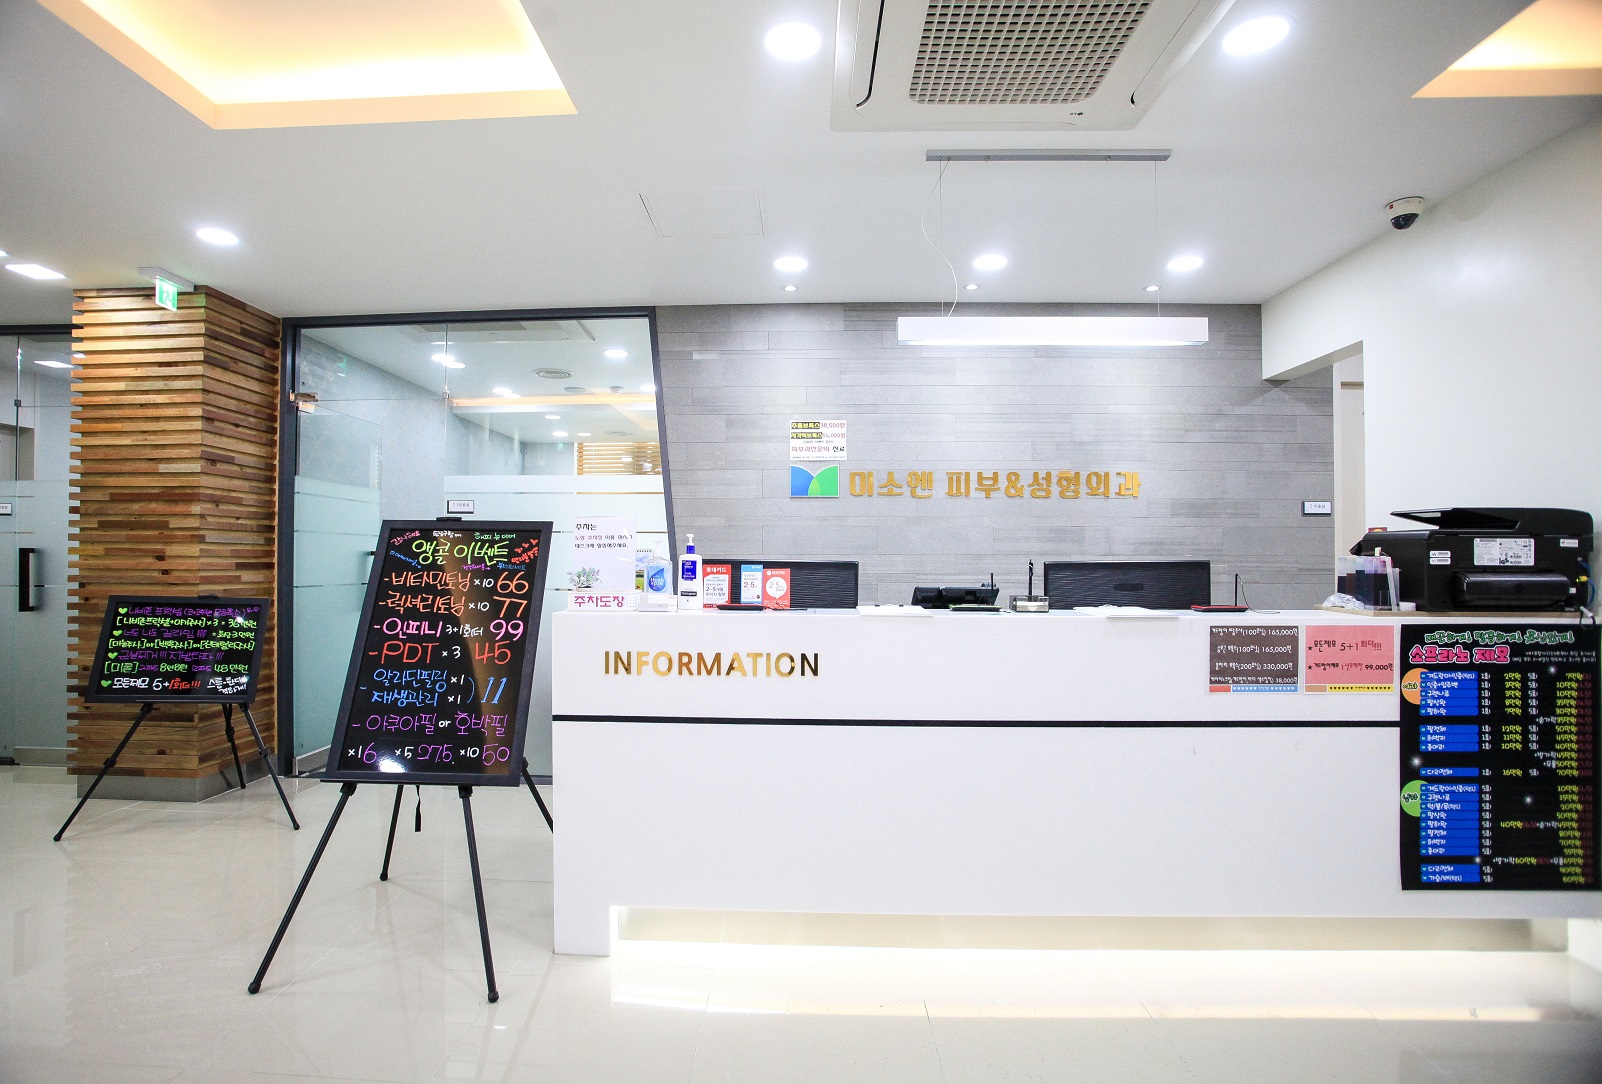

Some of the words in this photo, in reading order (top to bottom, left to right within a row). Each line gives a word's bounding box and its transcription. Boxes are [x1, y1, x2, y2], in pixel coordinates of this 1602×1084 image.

[849, 471, 934, 499] 미소엔
[945, 470, 1142, 499] 피부&성형외과
[575, 523, 597, 531] 주차는
[412, 539, 450, 565] 앵콜
[454, 541, 509, 567] 이벤트
[497, 571, 529, 594] 66
[493, 595, 528, 618] 77
[574, 595, 626, 609] 주차도장
[489, 619, 524, 642] 99
[1268, 627, 1298, 637] 165,000원
[381, 641, 440, 665] PDT
[475, 641, 512, 665] 45
[1261, 645, 1292, 655] 165,000원
[1313, 640, 1337, 653] 모든제모
[1409, 645, 1471, 664] 소프라노
[1473, 645, 1510, 664] 제모
[604, 651, 819, 677] INFORMATION
[1263, 662, 1294, 671] 330,000원
[1364, 662, 1394, 672] 99,000원
[112, 677, 150, 689] 모든제모
[373, 669, 448, 693] 알라딘필링
[371, 688, 438, 707] 재생관리
[438, 719, 452, 728] or
[454, 711, 508, 737] 호박필
[482, 743, 510, 766] 50
